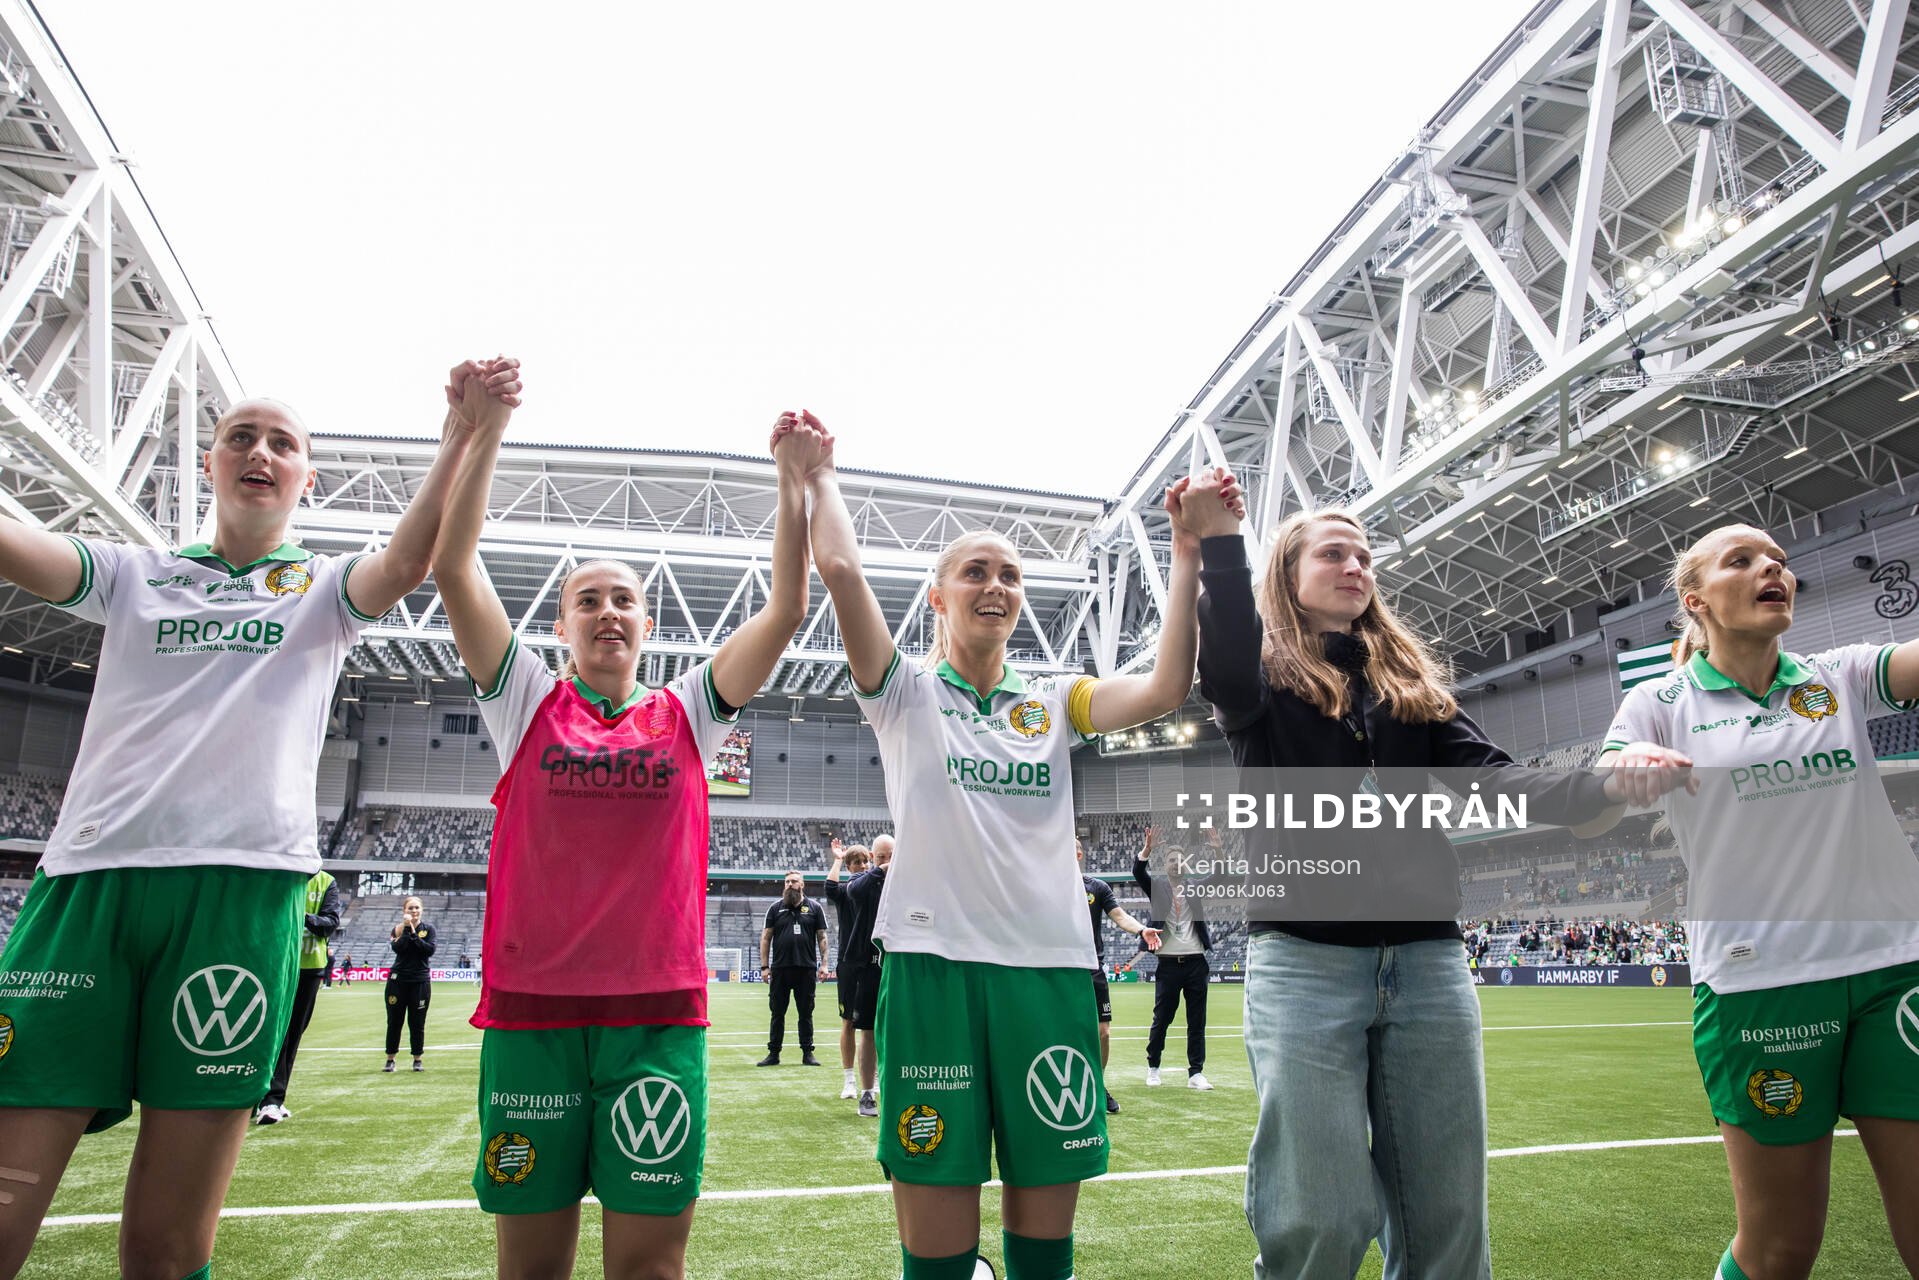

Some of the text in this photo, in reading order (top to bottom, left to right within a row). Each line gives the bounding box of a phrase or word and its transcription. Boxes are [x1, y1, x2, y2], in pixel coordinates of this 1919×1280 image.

[223, 583, 253, 592] SPORT
[156, 619, 285, 645] PROJOB
[155, 643, 225, 654] PROFESSIONAL
[1692, 719, 1729, 733] CRAFT
[549, 759, 670, 789] PROJOB
[947, 753, 1051, 788] PROJOB
[1729, 748, 1857, 794] PROJOB
[548, 788, 670, 801] PROFESSIONAL WORKWEAR
[1003, 788, 1051, 798] WORKWEAR
[1737, 785, 1807, 803] PROFESSIONAL
[0, 970, 96, 988] OSPHORUS
[431, 970, 477, 980] ERSPORT
[1537, 970, 1619, 984] HAMMARBY IF
[1741, 1021, 1841, 1043] BOSPHORUS
[1763, 1037, 1823, 1054] matkluster
[196, 1064, 244, 1075] CRAFT
[901, 1064, 974, 1079] BOSPHOR
[916, 1078, 971, 1091] matkluster
[490, 1091, 583, 1108] BOSPHORUS
[506, 1107, 565, 1120] matkluster
[1063, 1136, 1098, 1150] CRAFT
[630, 1171, 673, 1184] CRAFT
